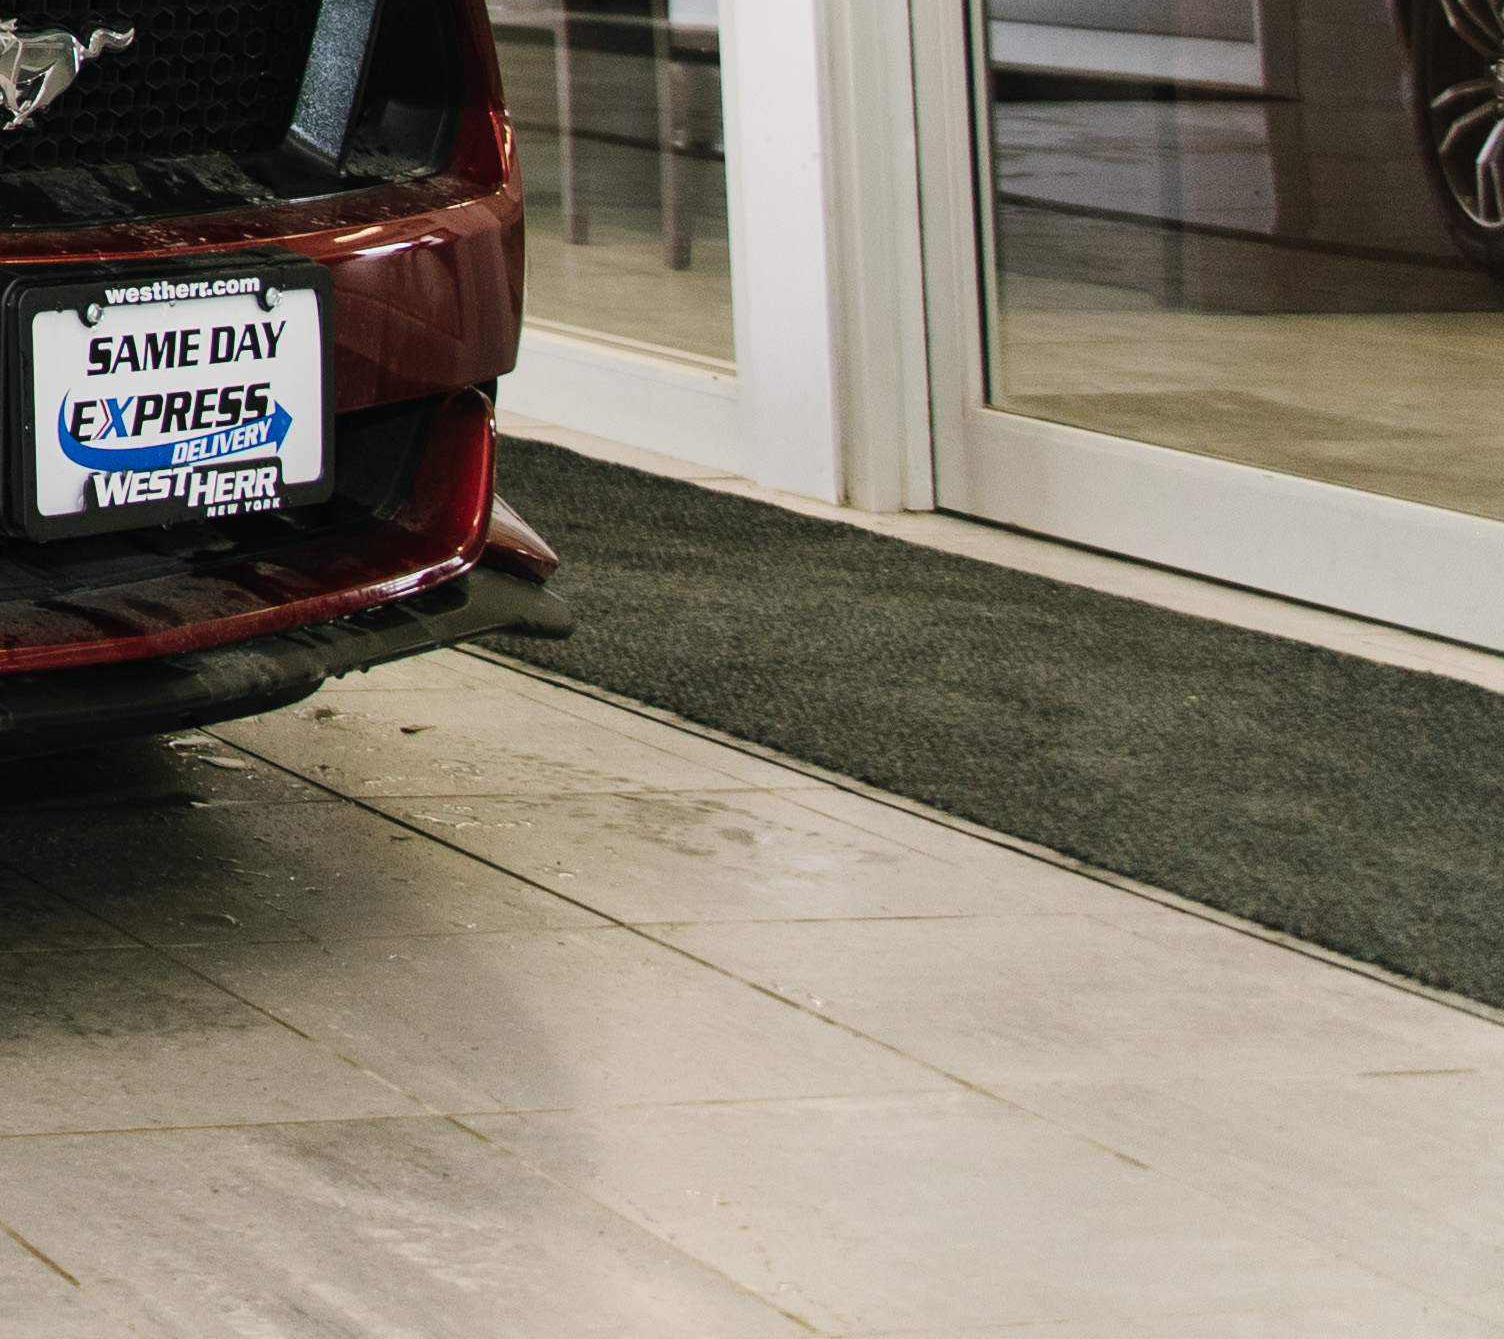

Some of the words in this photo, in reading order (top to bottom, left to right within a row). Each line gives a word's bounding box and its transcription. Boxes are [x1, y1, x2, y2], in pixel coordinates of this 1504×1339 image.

[104, 277, 261, 304] westherr.com
[87, 328, 201, 376] SAME
[208, 320, 287, 365] DAY
[69, 381, 271, 443] EXPRESS
[171, 418, 273, 465] DELIVERY
[207, 504, 239, 518] NEW
[244, 497, 281, 514] YORK
